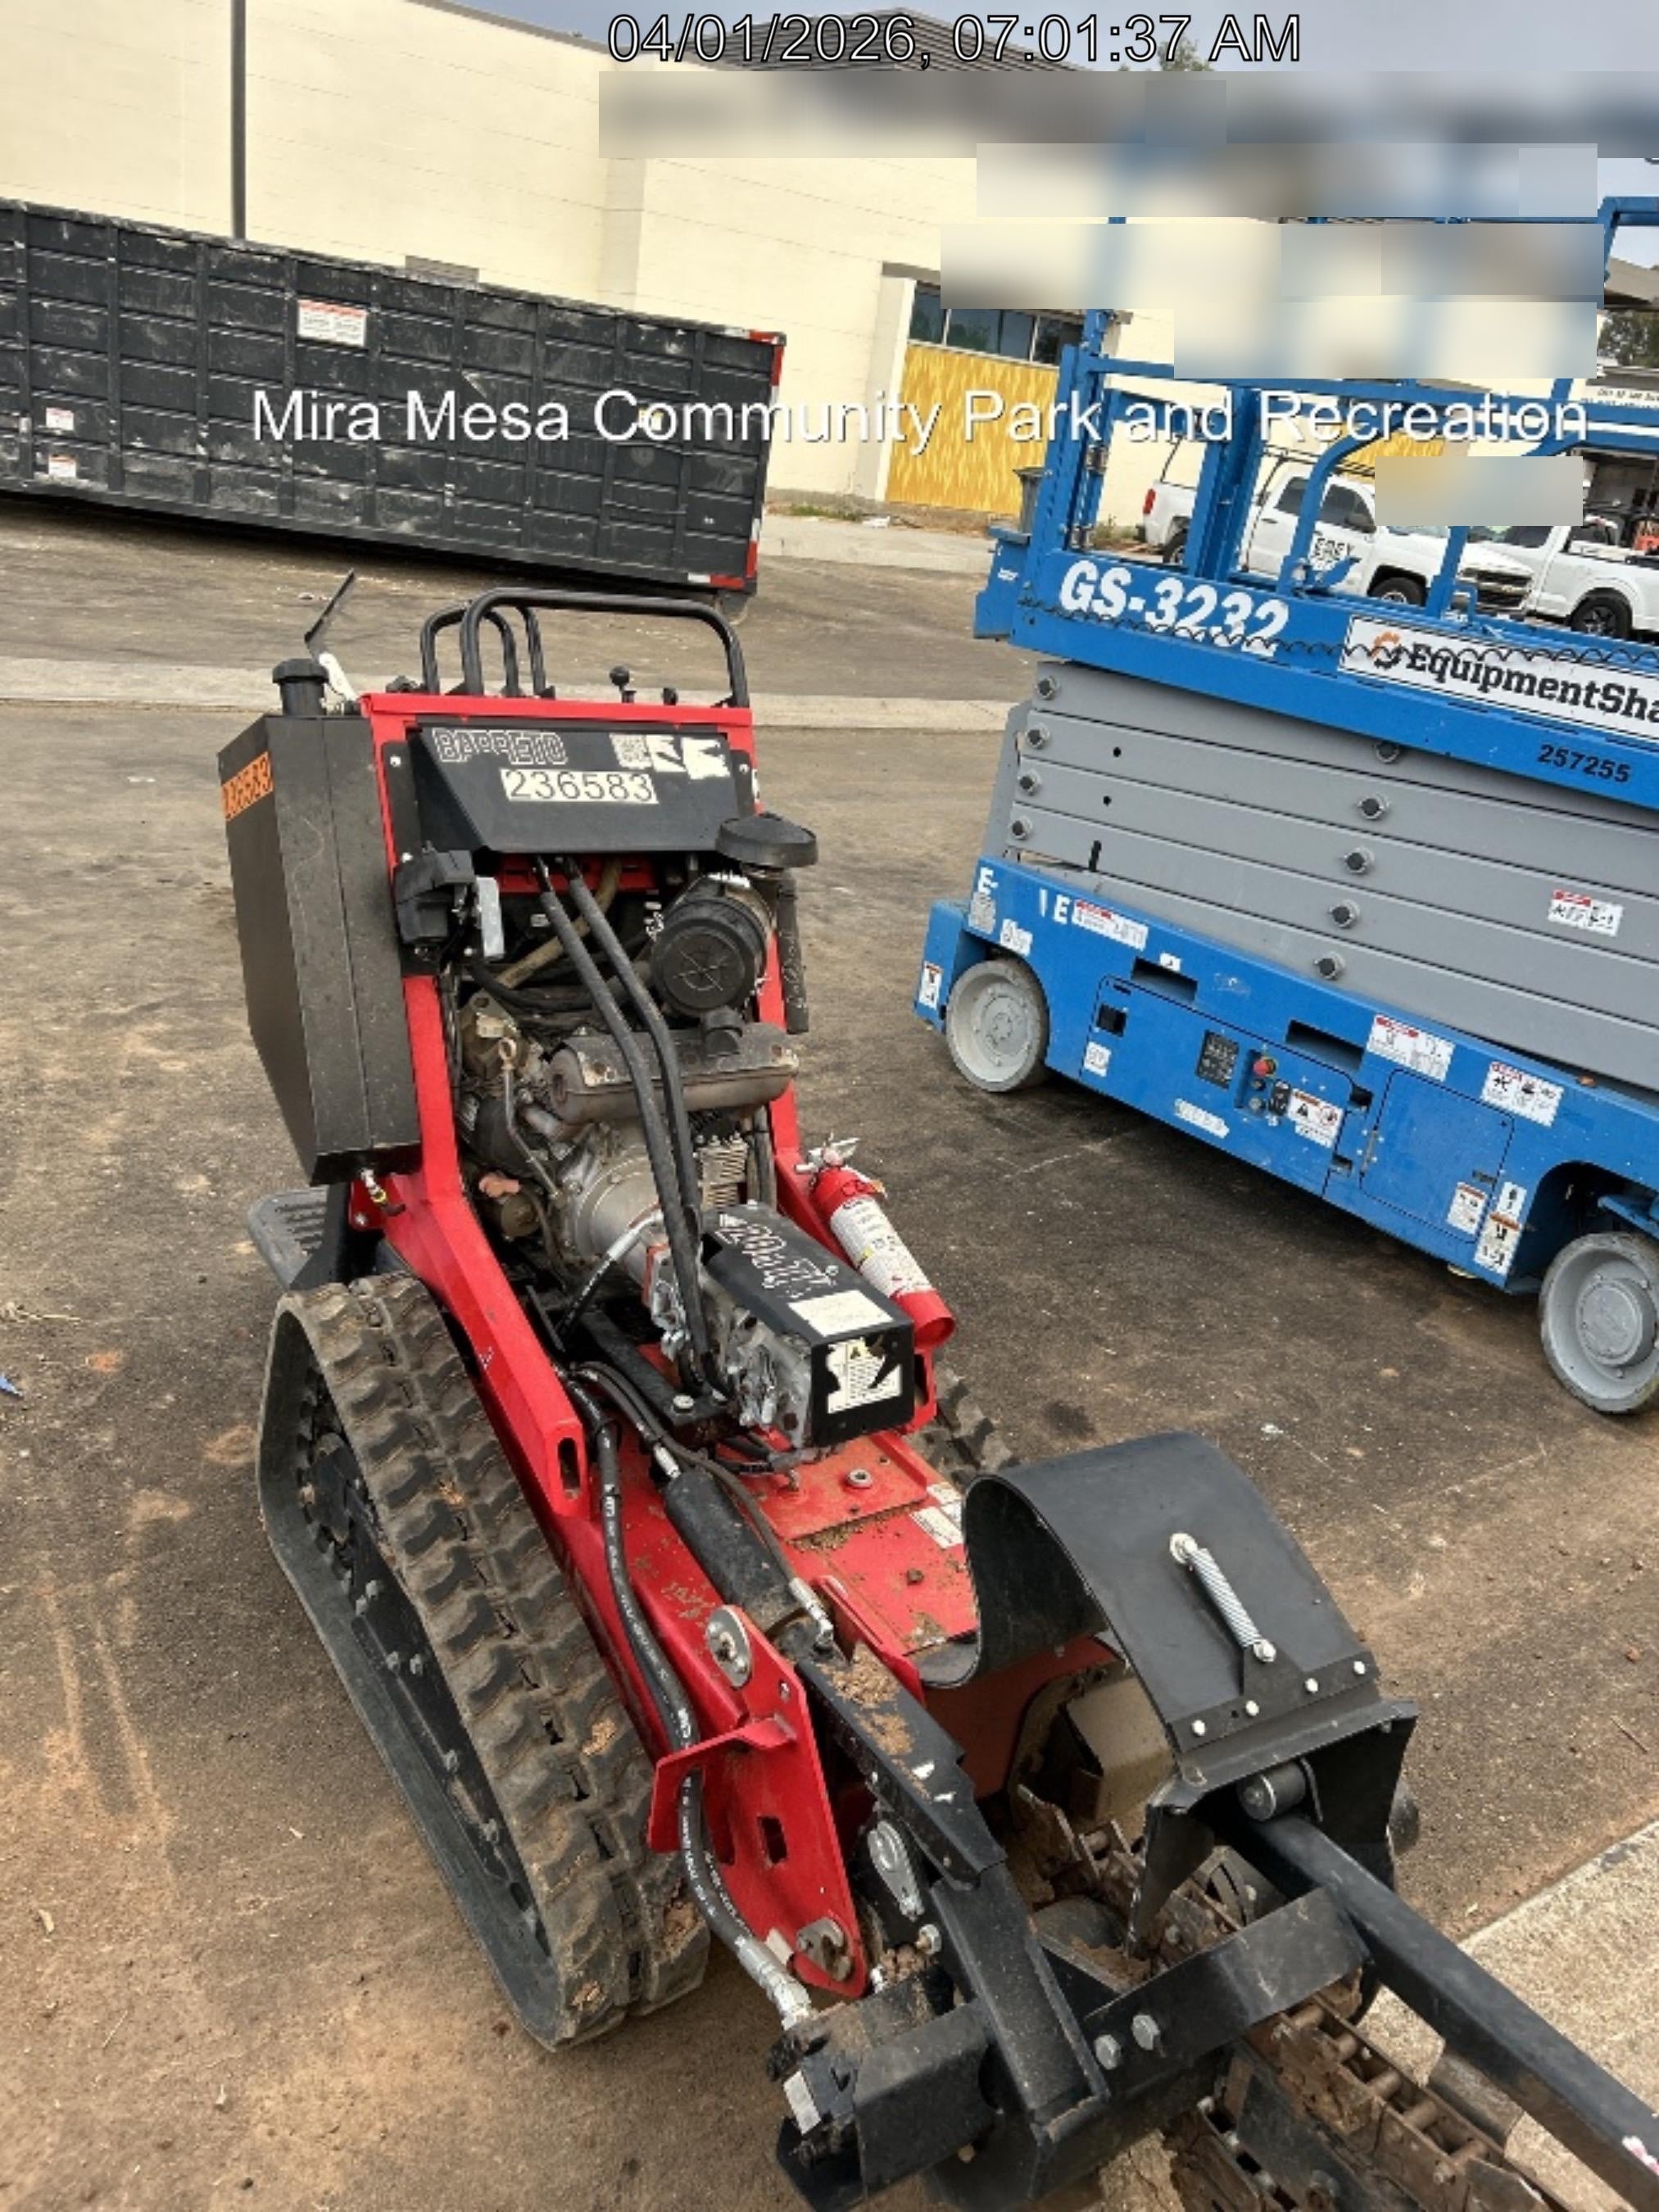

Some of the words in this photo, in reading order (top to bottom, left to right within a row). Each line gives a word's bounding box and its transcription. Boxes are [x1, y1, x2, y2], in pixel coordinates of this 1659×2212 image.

[1059, 560, 1290, 657] GS-3232
[1538, 744, 1631, 784] 257255
[505, 770, 653, 802] 236583
